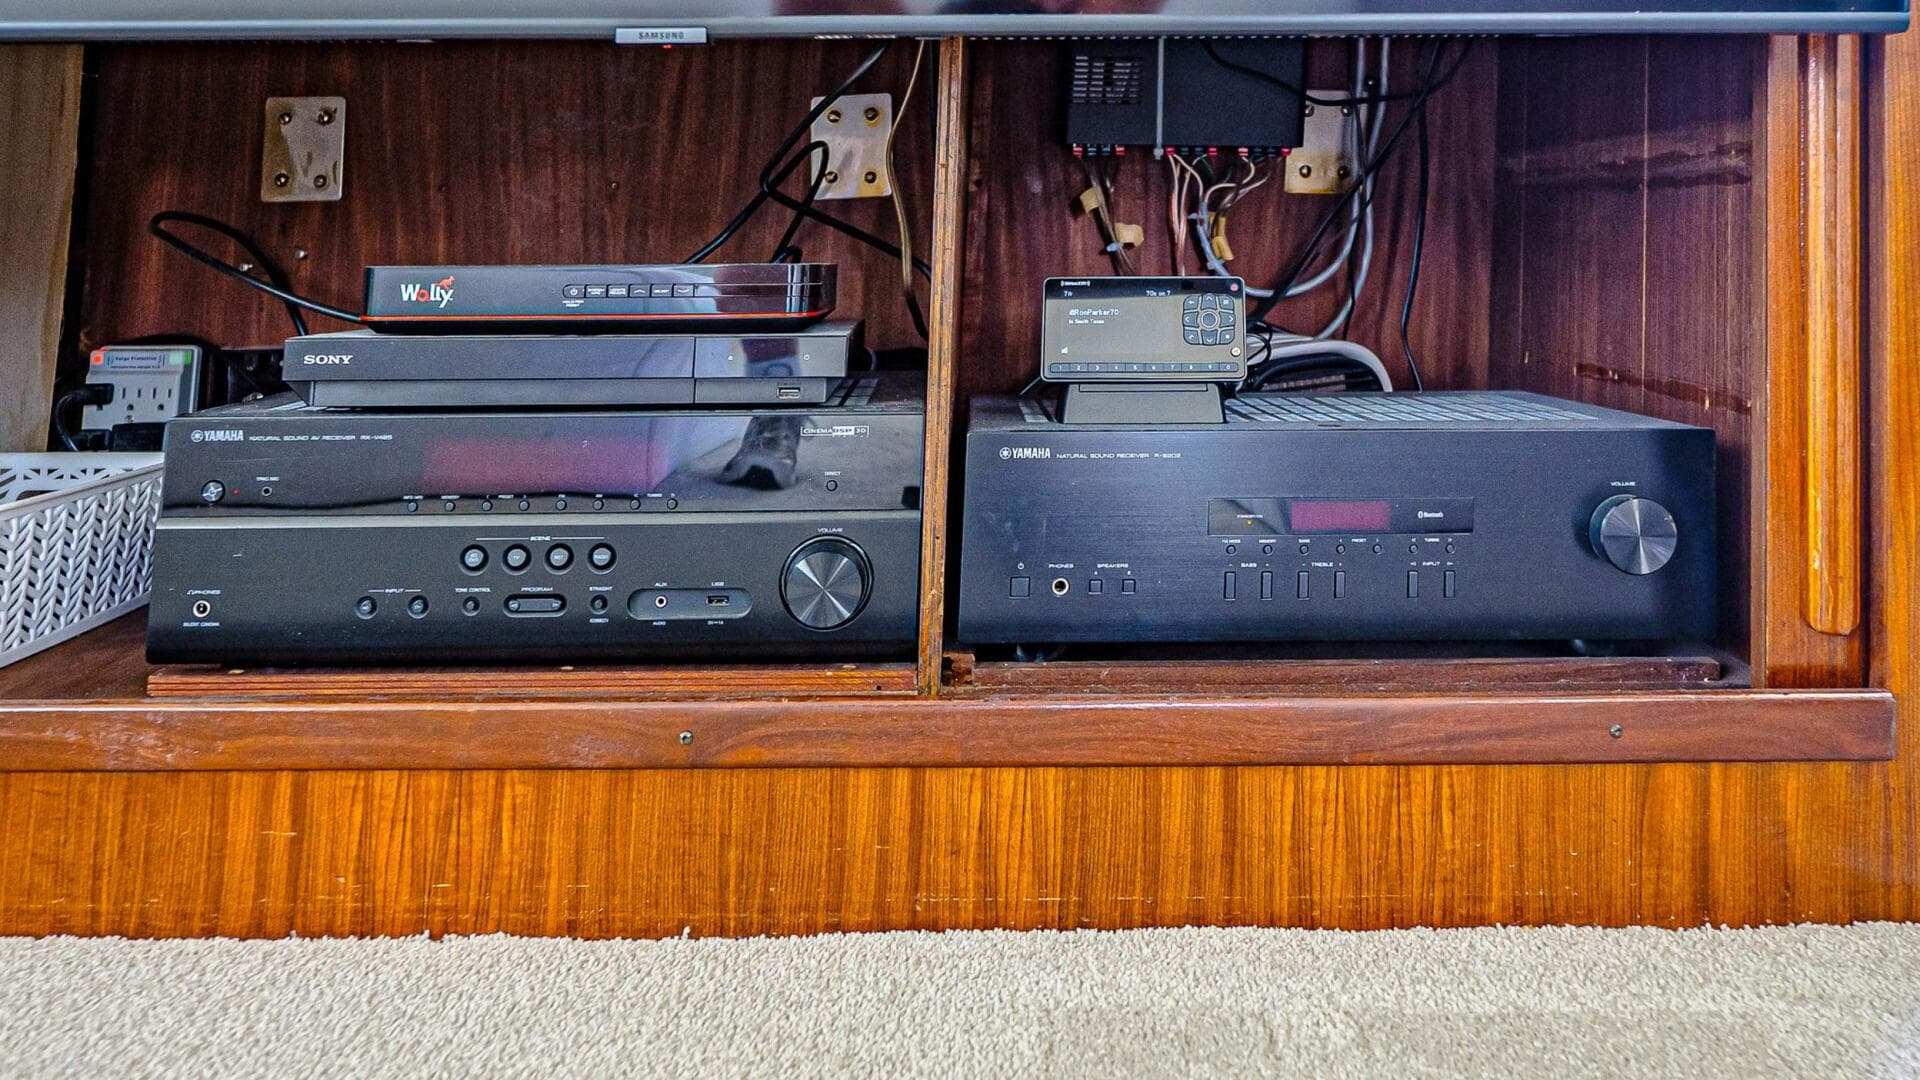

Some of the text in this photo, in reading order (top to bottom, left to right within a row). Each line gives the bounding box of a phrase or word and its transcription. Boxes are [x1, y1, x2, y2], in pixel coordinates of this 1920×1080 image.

[638, 31, 685, 40] SAMSUNG
[303, 354, 353, 365] SONY
[204, 430, 244, 441] YAMAHA
[1012, 448, 1051, 459] YAMAHA
